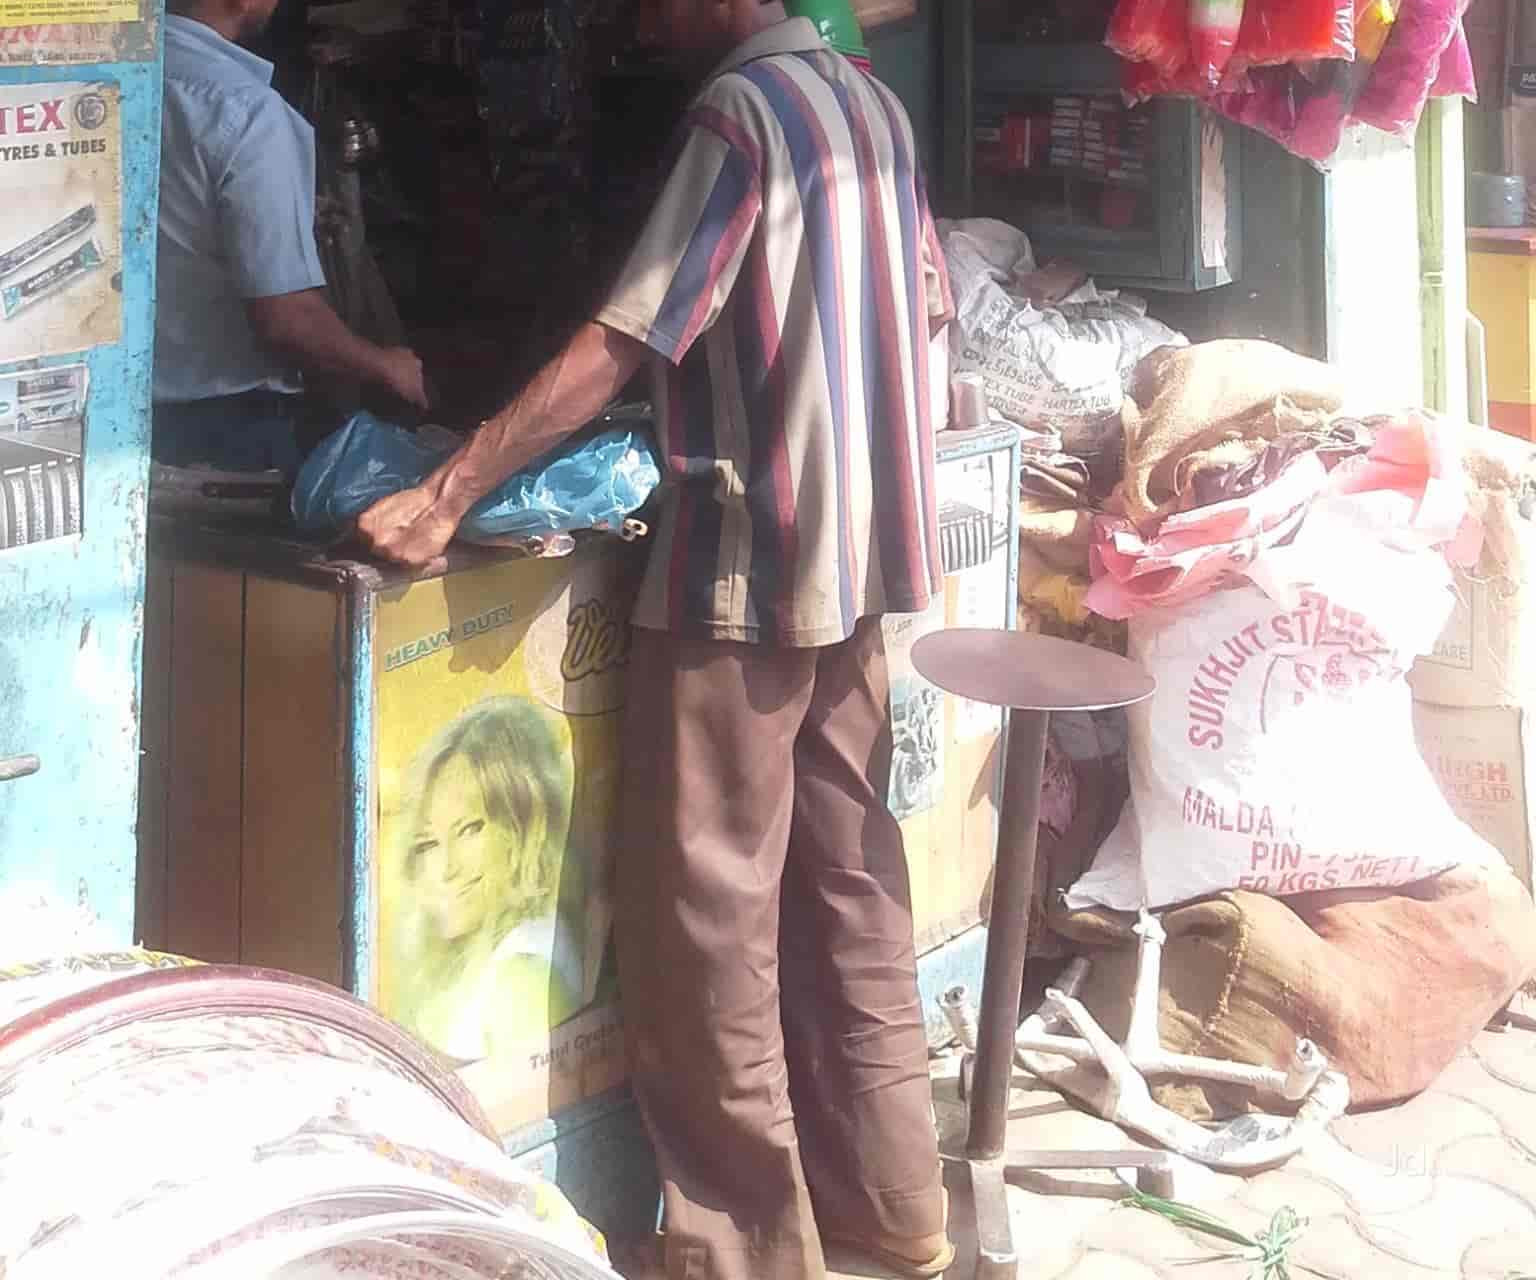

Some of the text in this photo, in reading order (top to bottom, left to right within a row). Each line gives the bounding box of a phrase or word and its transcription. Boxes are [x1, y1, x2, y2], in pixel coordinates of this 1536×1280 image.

[44, 143, 57, 157] &
[61, 138, 107, 156] TUBES
[384, 602, 514, 672] HEAVY DUTY
[1188, 623, 1267, 752] SUKHJIT
